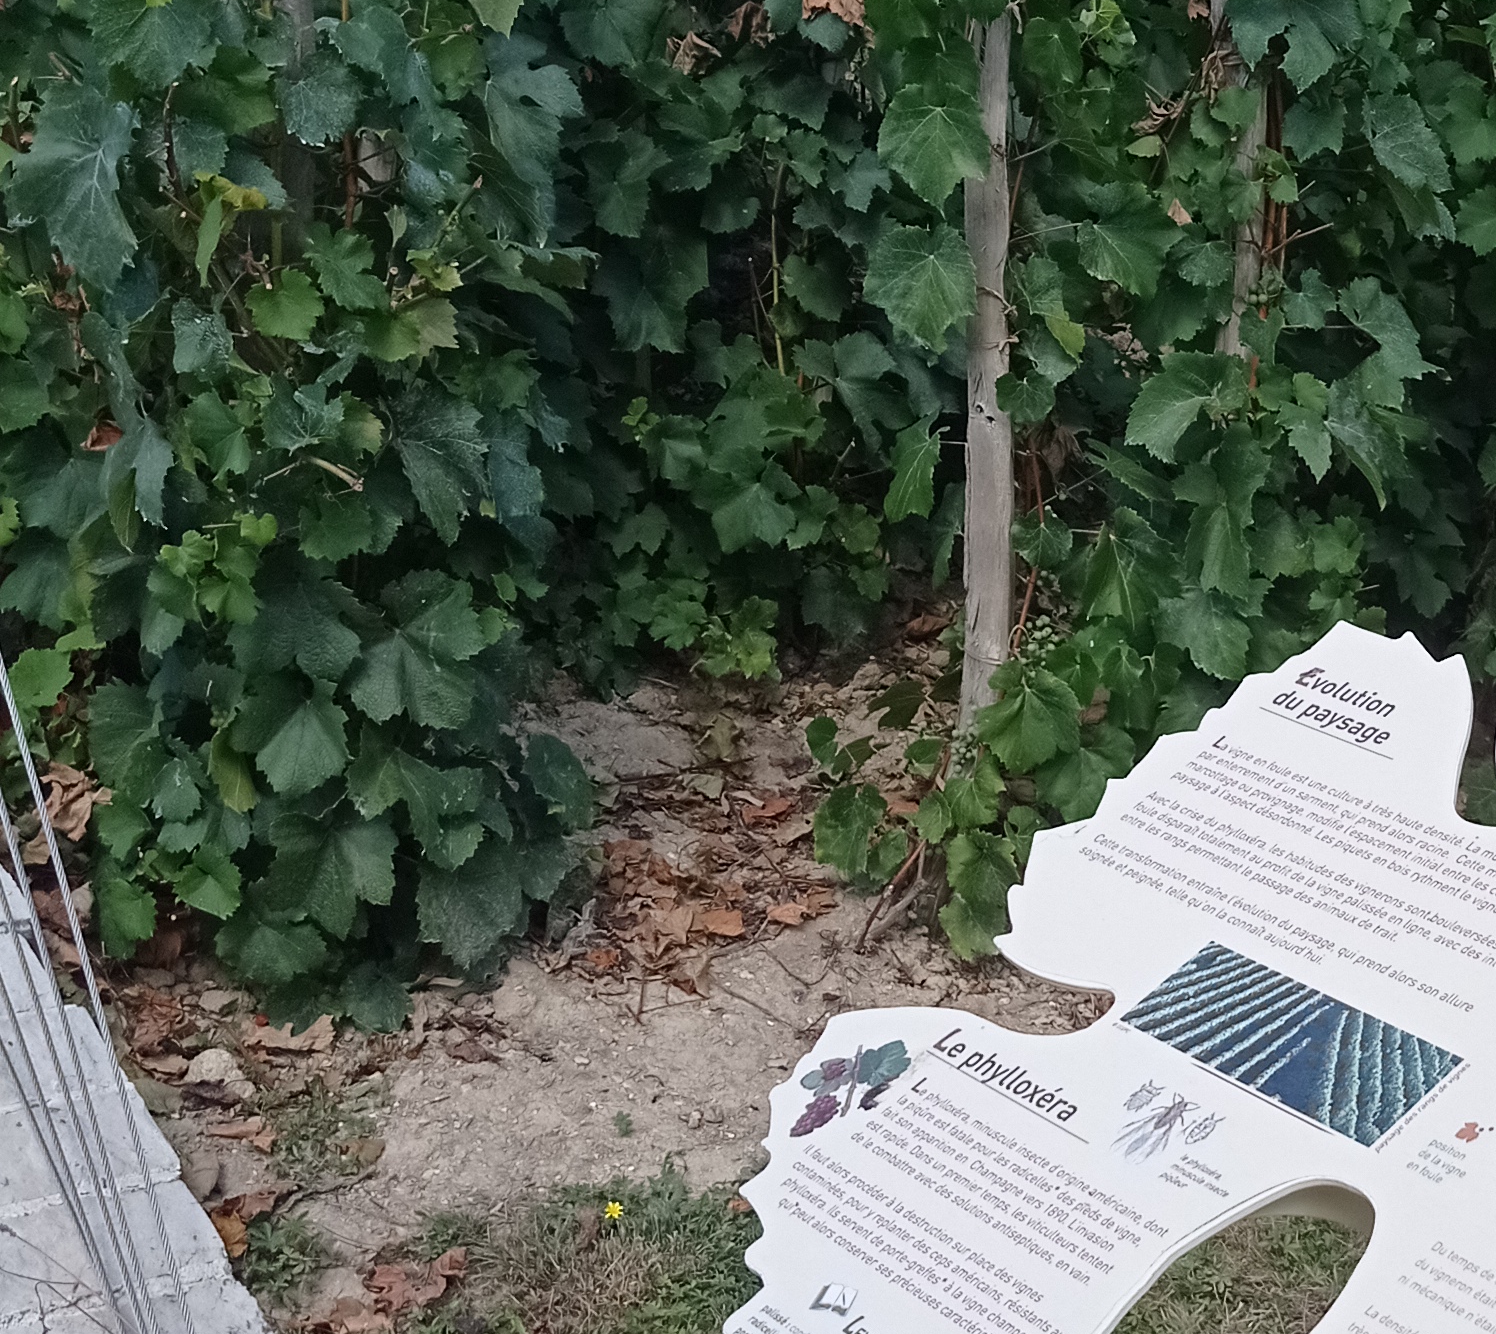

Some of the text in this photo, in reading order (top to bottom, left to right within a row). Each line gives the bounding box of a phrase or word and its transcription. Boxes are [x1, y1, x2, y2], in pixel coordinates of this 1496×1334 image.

[1271, 690, 1391, 745] du paysage
[932, 1027, 1078, 1127] Le phylloxéra
